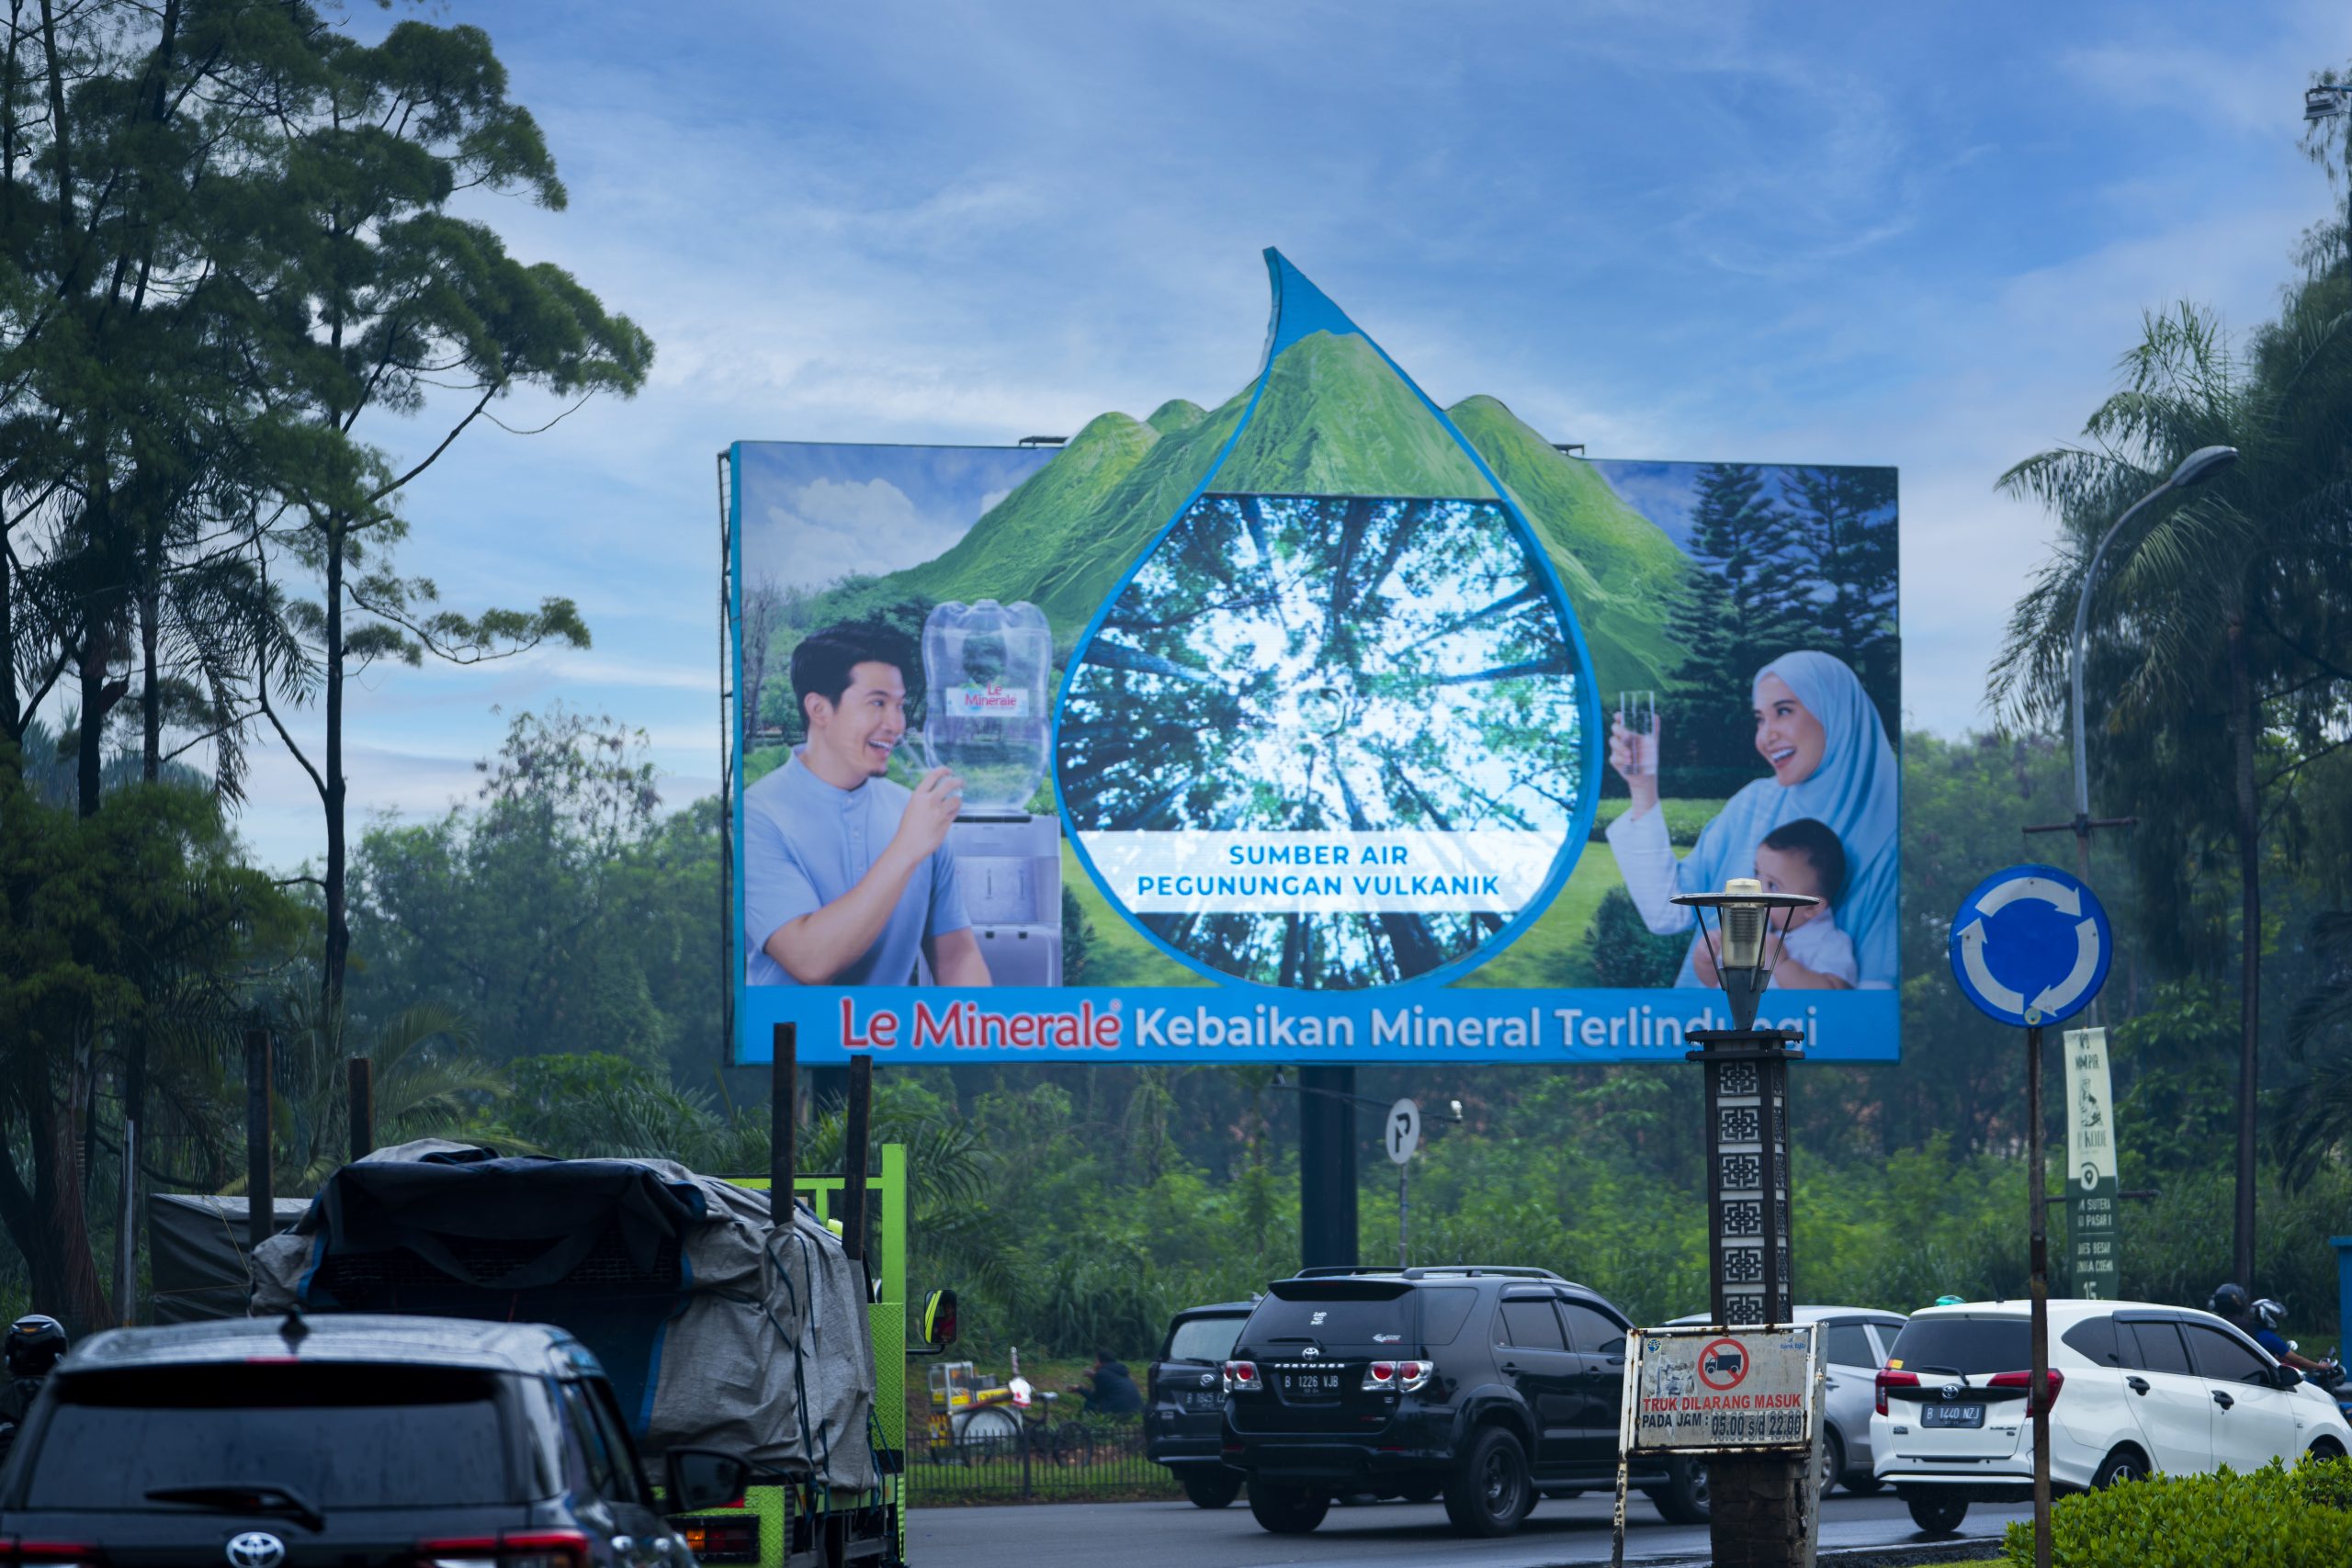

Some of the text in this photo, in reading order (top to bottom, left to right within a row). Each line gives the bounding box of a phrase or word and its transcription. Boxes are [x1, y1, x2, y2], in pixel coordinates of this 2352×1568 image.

[965, 692, 1017, 706] Minerale
[1228, 845, 1408, 865] SUMBER AIR
[1137, 875, 1499, 897] PEGUNUNGAN VULKANIK
[840, 998, 899, 1048] Le
[1136, 1004, 1354, 1047] Kebaikan
[1371, 1005, 1541, 1047] Mineral
[1284, 1375, 1292, 1388] B
[1298, 1375, 1318, 1388] 1226
[1643, 1393, 1802, 1412] TRUK DILARANG MASUK
[1642, 1414, 1673, 1428] PADA
[1677, 1413, 1702, 1427] JAM
[1927, 1407, 1980, 1419] B 1440 NZJ
